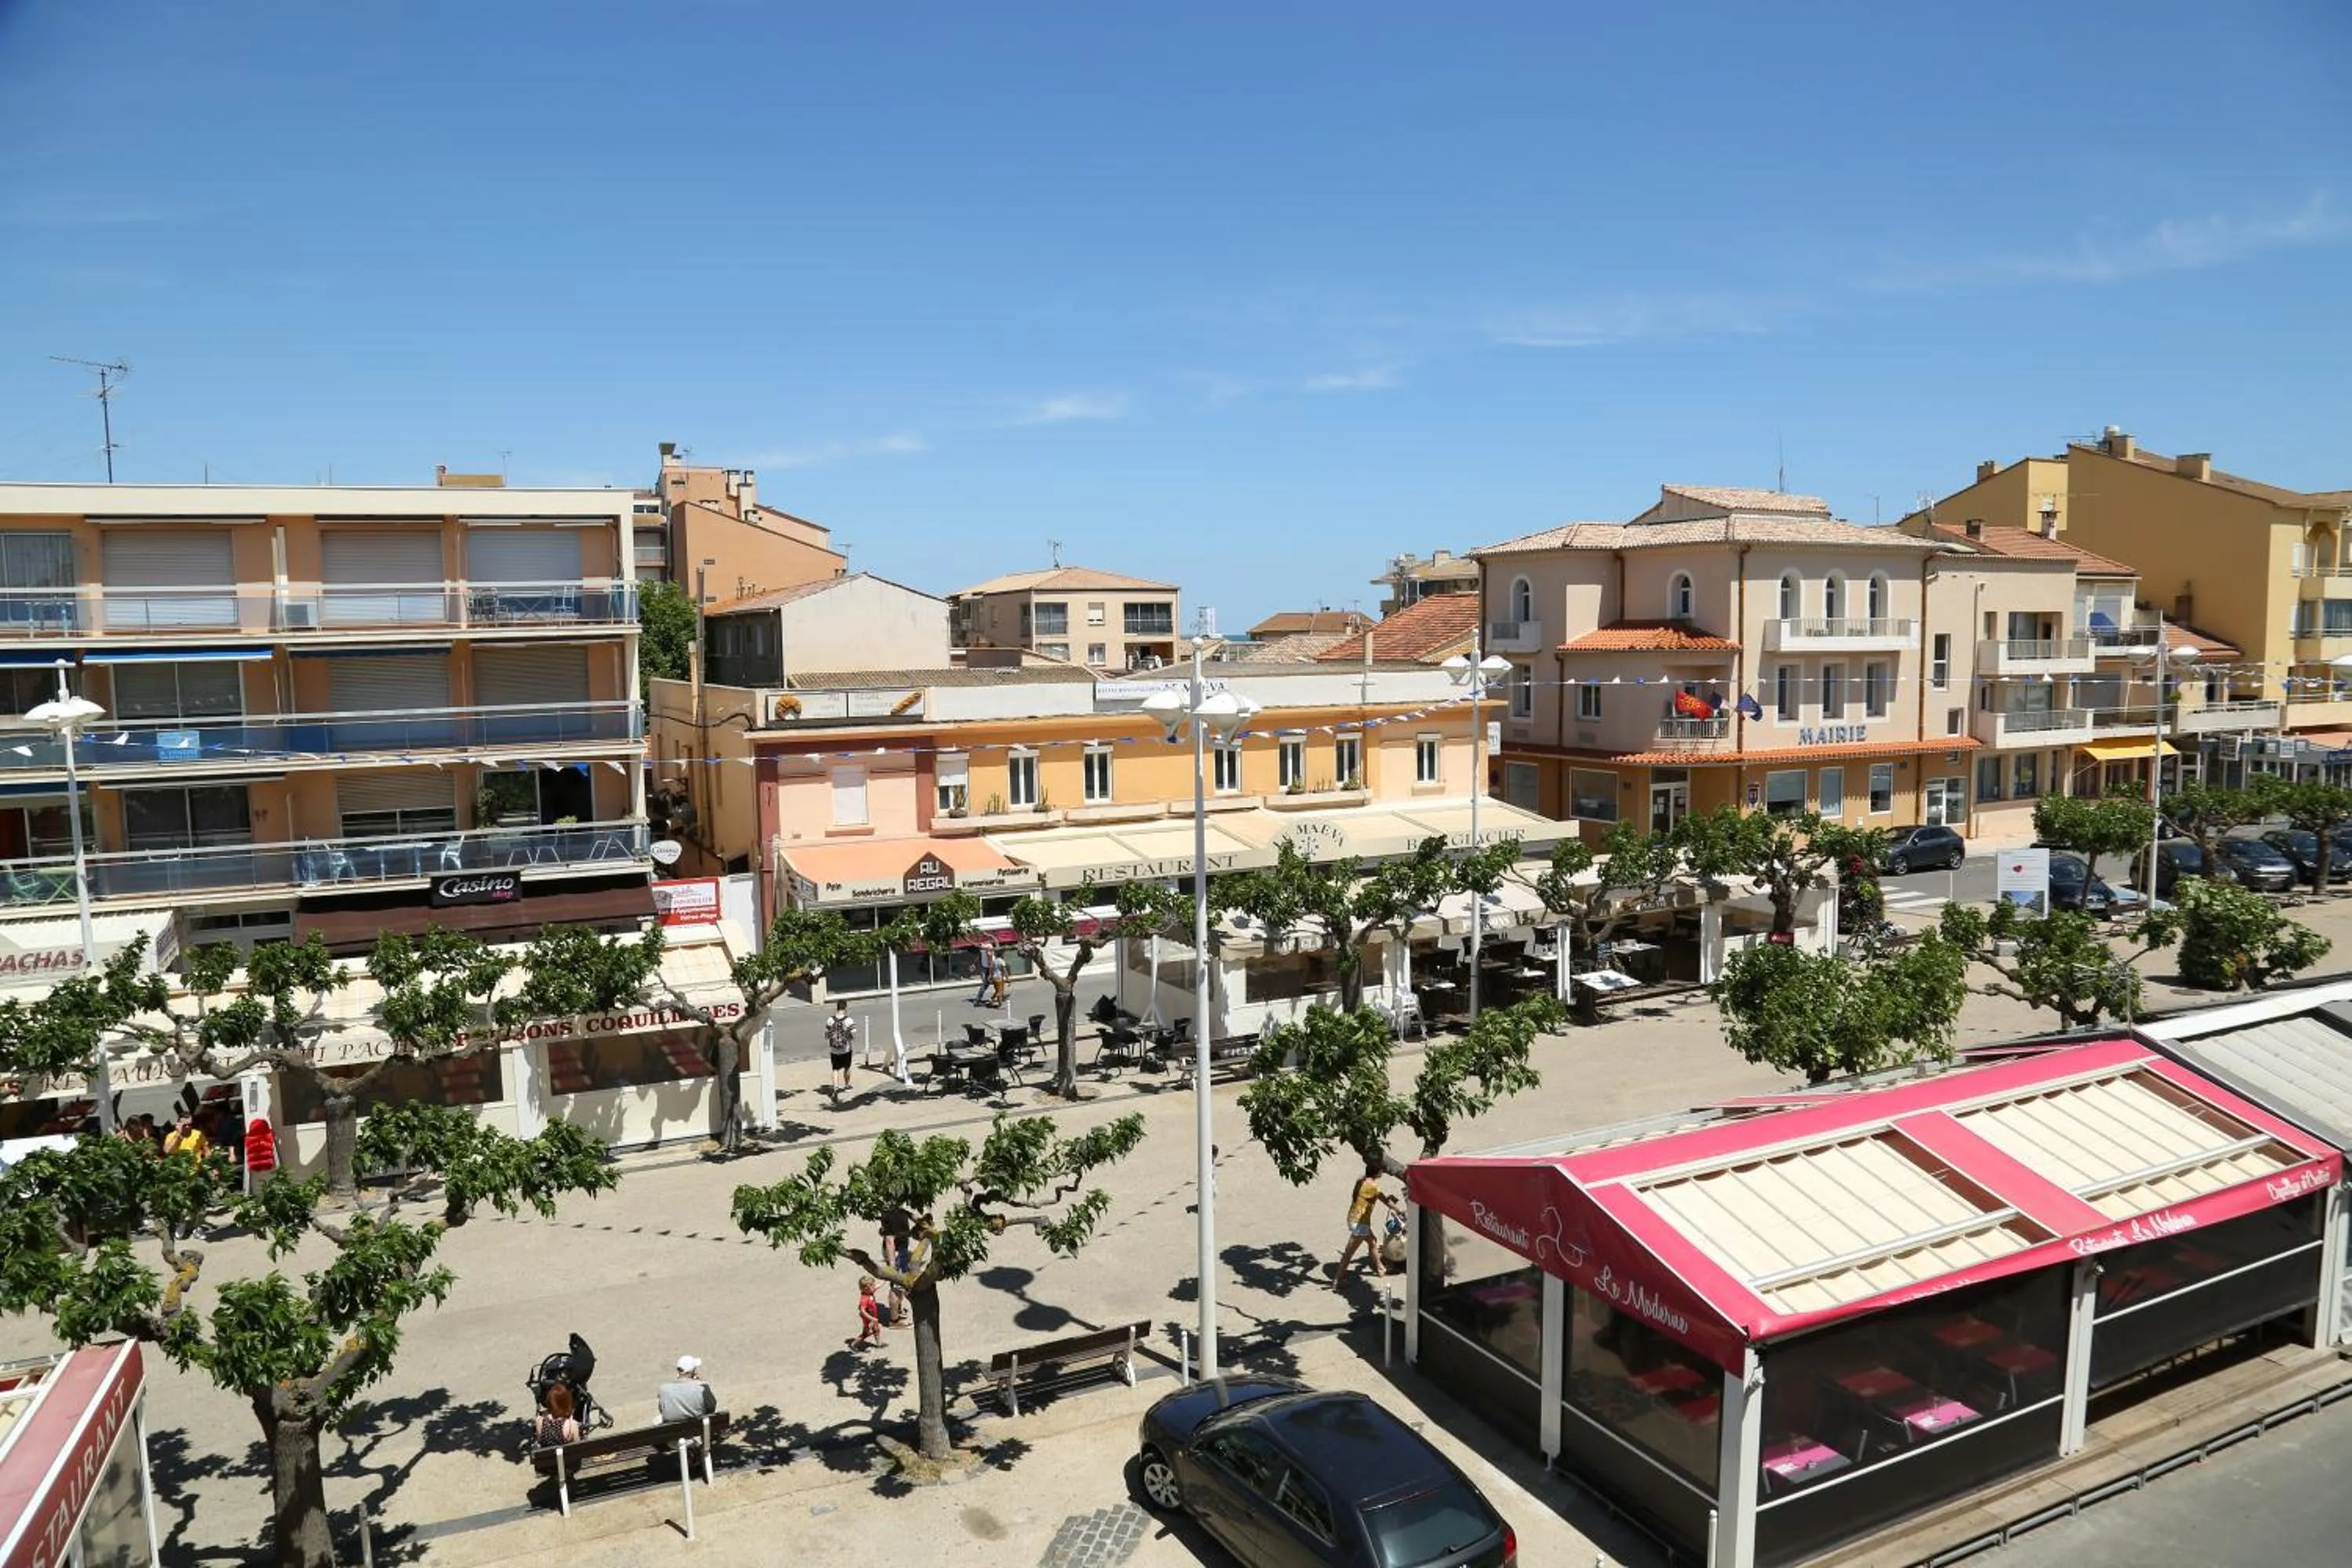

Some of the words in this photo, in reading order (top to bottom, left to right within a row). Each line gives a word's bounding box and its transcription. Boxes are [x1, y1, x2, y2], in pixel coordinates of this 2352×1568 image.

[1798, 725, 1867, 745] MAIRIE
[1296, 823, 1343, 847] MAEVA
[1451, 829, 1526, 846] GLACIER
[919, 861, 940, 874] AU
[1081, 855, 1238, 882] RESTAURNT
[439, 876, 514, 898] Casino
[907, 876, 953, 891] REGAL
[0, 949, 84, 973] ACHAS
[586, 1003, 740, 1033] COQUILLES
[339, 1038, 409, 1060] PACH
[1594, 1265, 1621, 1300] Le
[1623, 1281, 1688, 1334] Moderne
[32, 1377, 125, 1568] STAURANT
